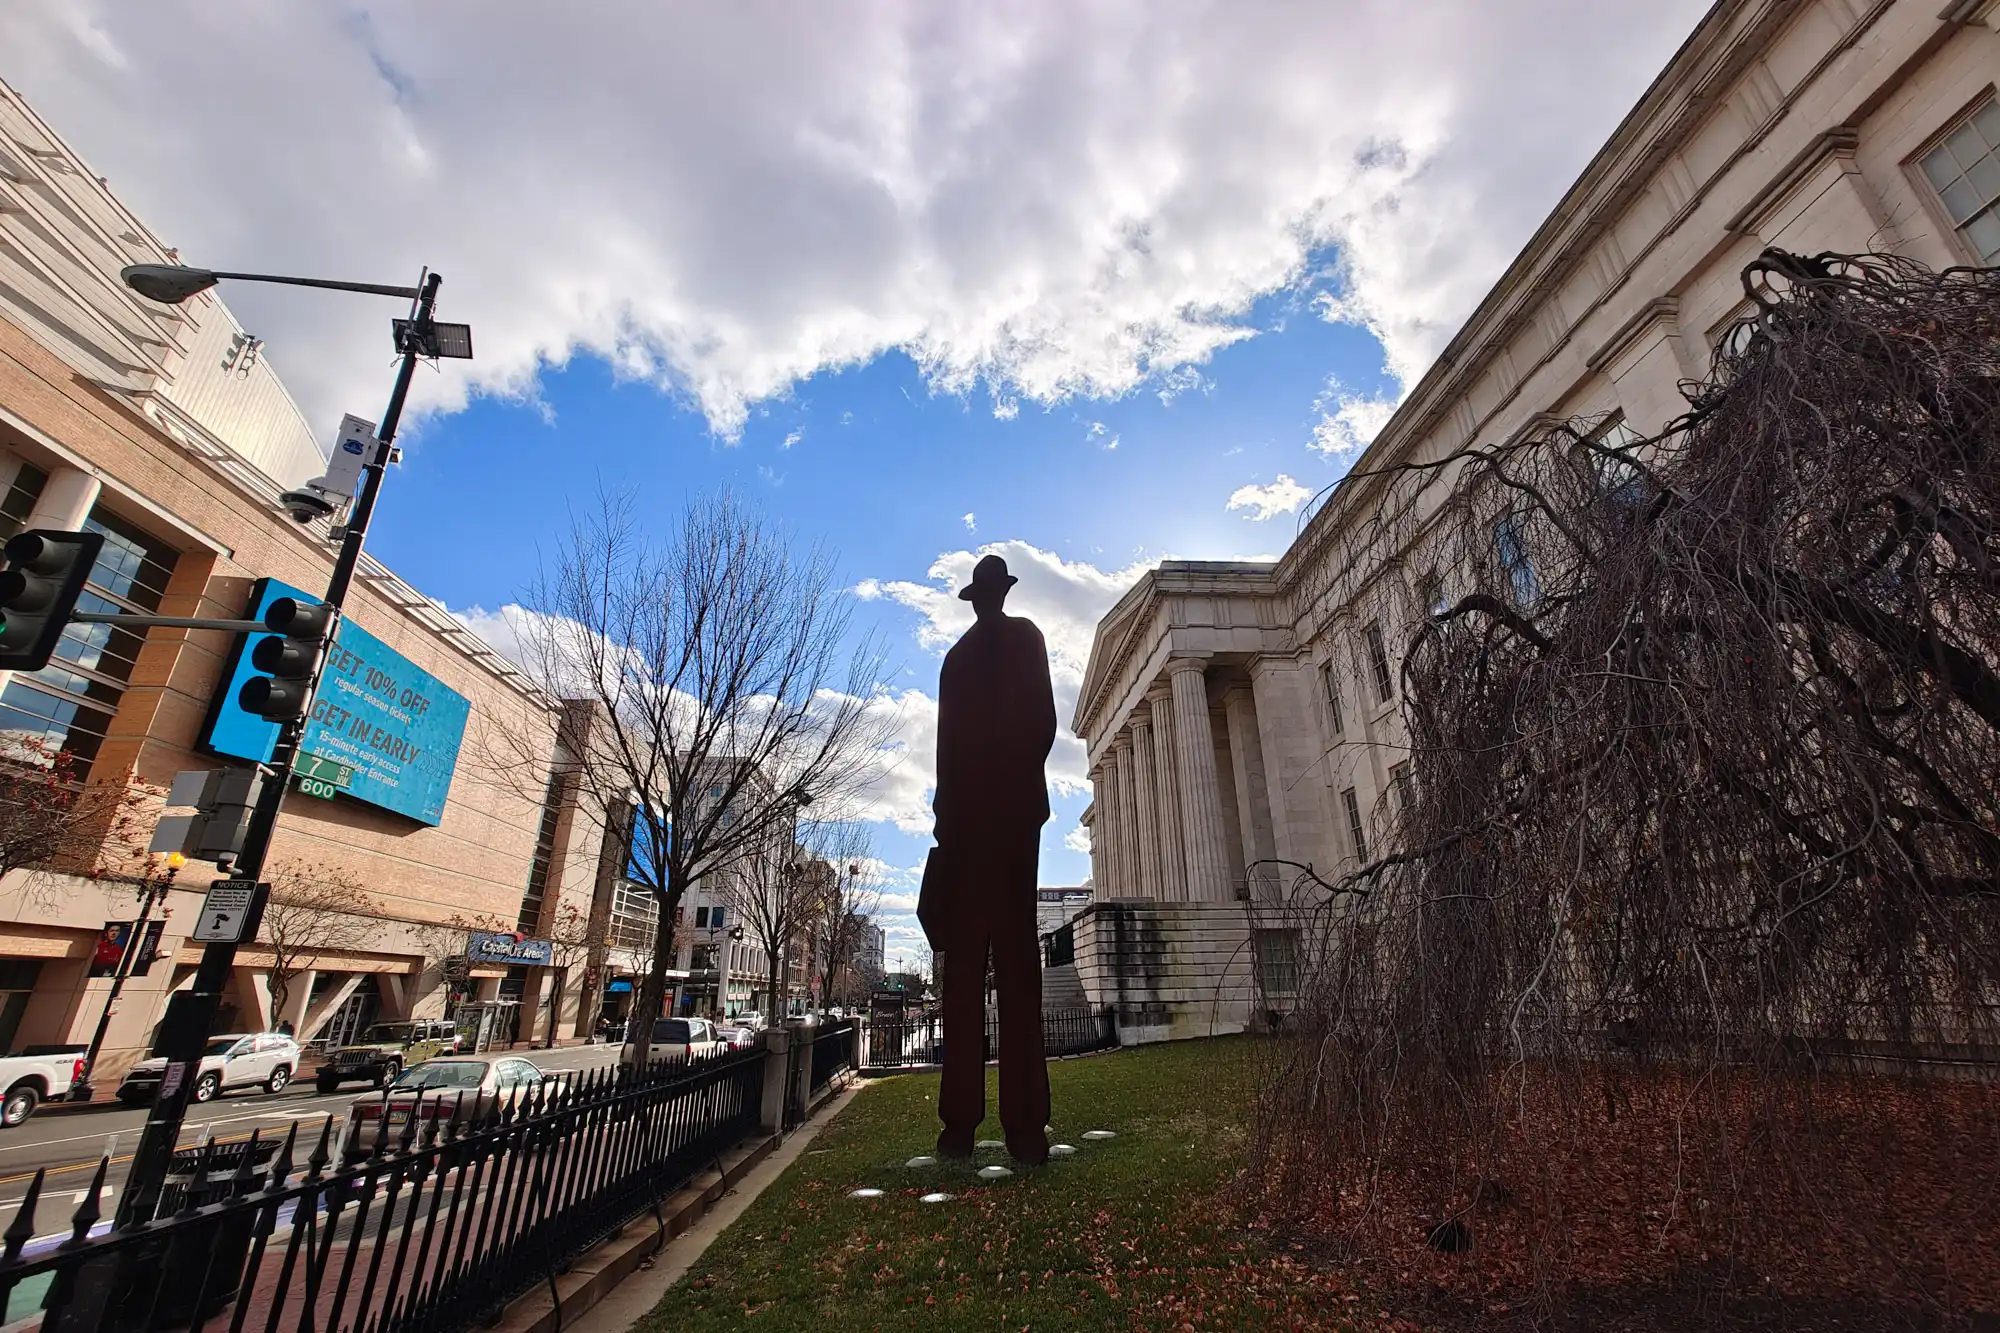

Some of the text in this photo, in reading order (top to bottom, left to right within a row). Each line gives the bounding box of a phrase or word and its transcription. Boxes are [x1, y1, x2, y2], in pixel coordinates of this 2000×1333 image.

[327, 643, 430, 715] GET 10% OFF
[334, 676, 412, 725] regular season tickets
[311, 699, 420, 764] GET IN EARLY
[319, 730, 401, 774] 15-minute early access
[301, 778, 334, 798] 600
[309, 756, 352, 777] 7 ST
[313, 746, 399, 788] at Cardholder Entrance
[522, 947, 545, 959] Arena
